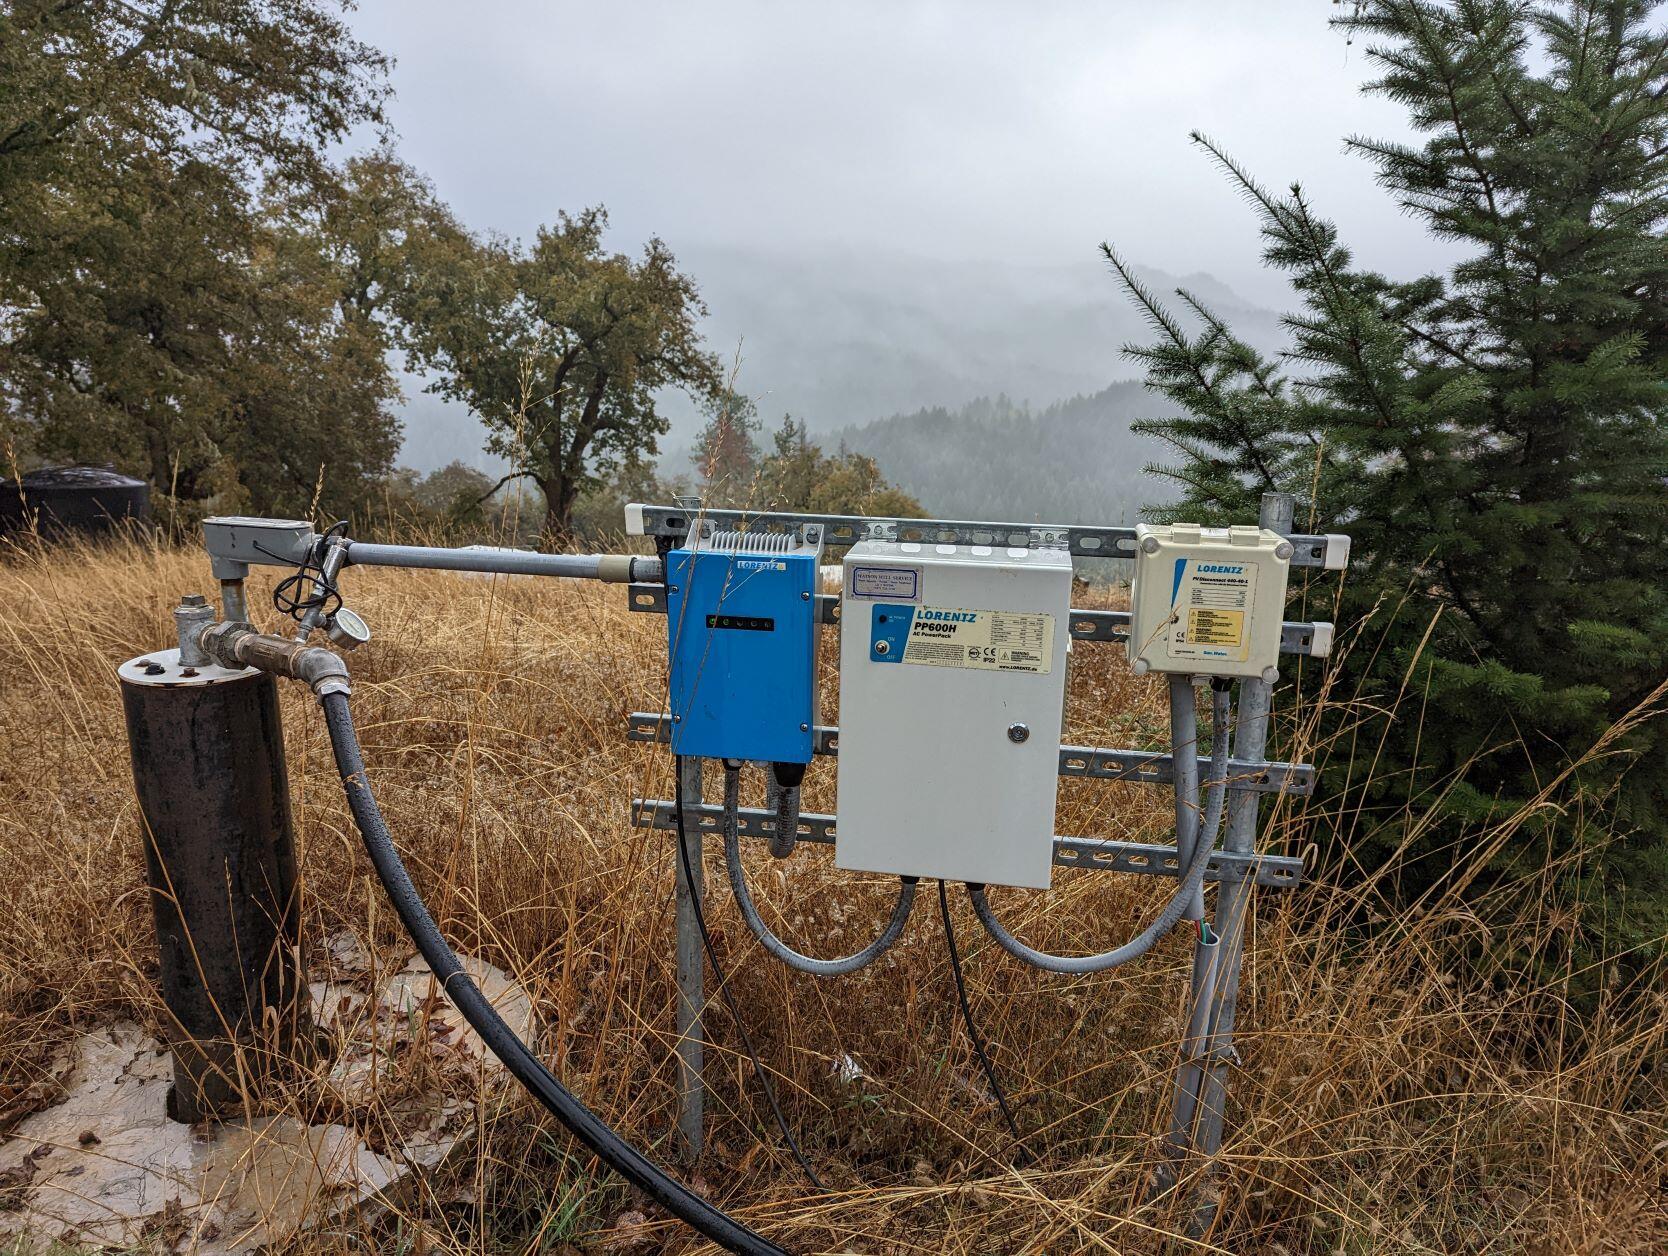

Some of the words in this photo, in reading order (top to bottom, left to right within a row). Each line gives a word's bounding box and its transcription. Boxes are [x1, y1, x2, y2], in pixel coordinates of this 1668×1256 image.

[739, 561, 778, 570] LORENTZ
[1197, 565, 1243, 574] LORENTZ
[917, 610, 977, 623] LORENTZ
[914, 622, 957, 633] PP600H
